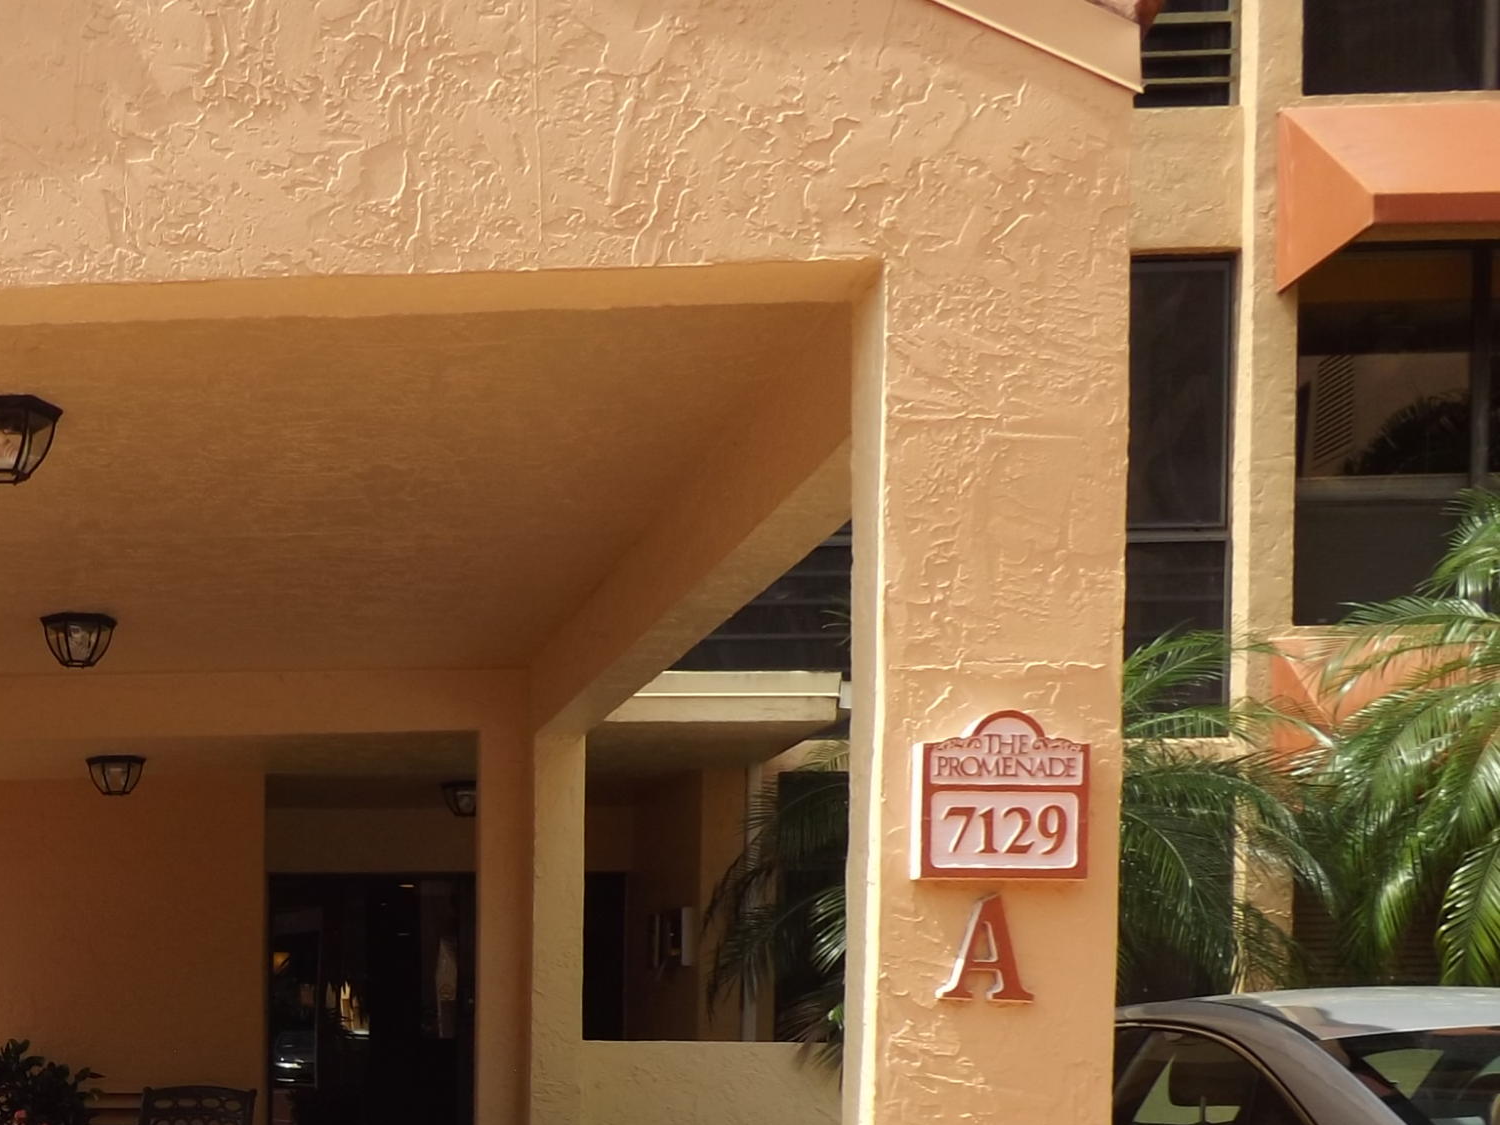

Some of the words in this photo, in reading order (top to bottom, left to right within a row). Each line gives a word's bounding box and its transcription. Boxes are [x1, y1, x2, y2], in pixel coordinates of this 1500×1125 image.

[985, 734, 1029, 754] THE
[934, 756, 1077, 777] PROMENADE
[941, 805, 1068, 855] 7129
[935, 893, 1034, 1003] A
